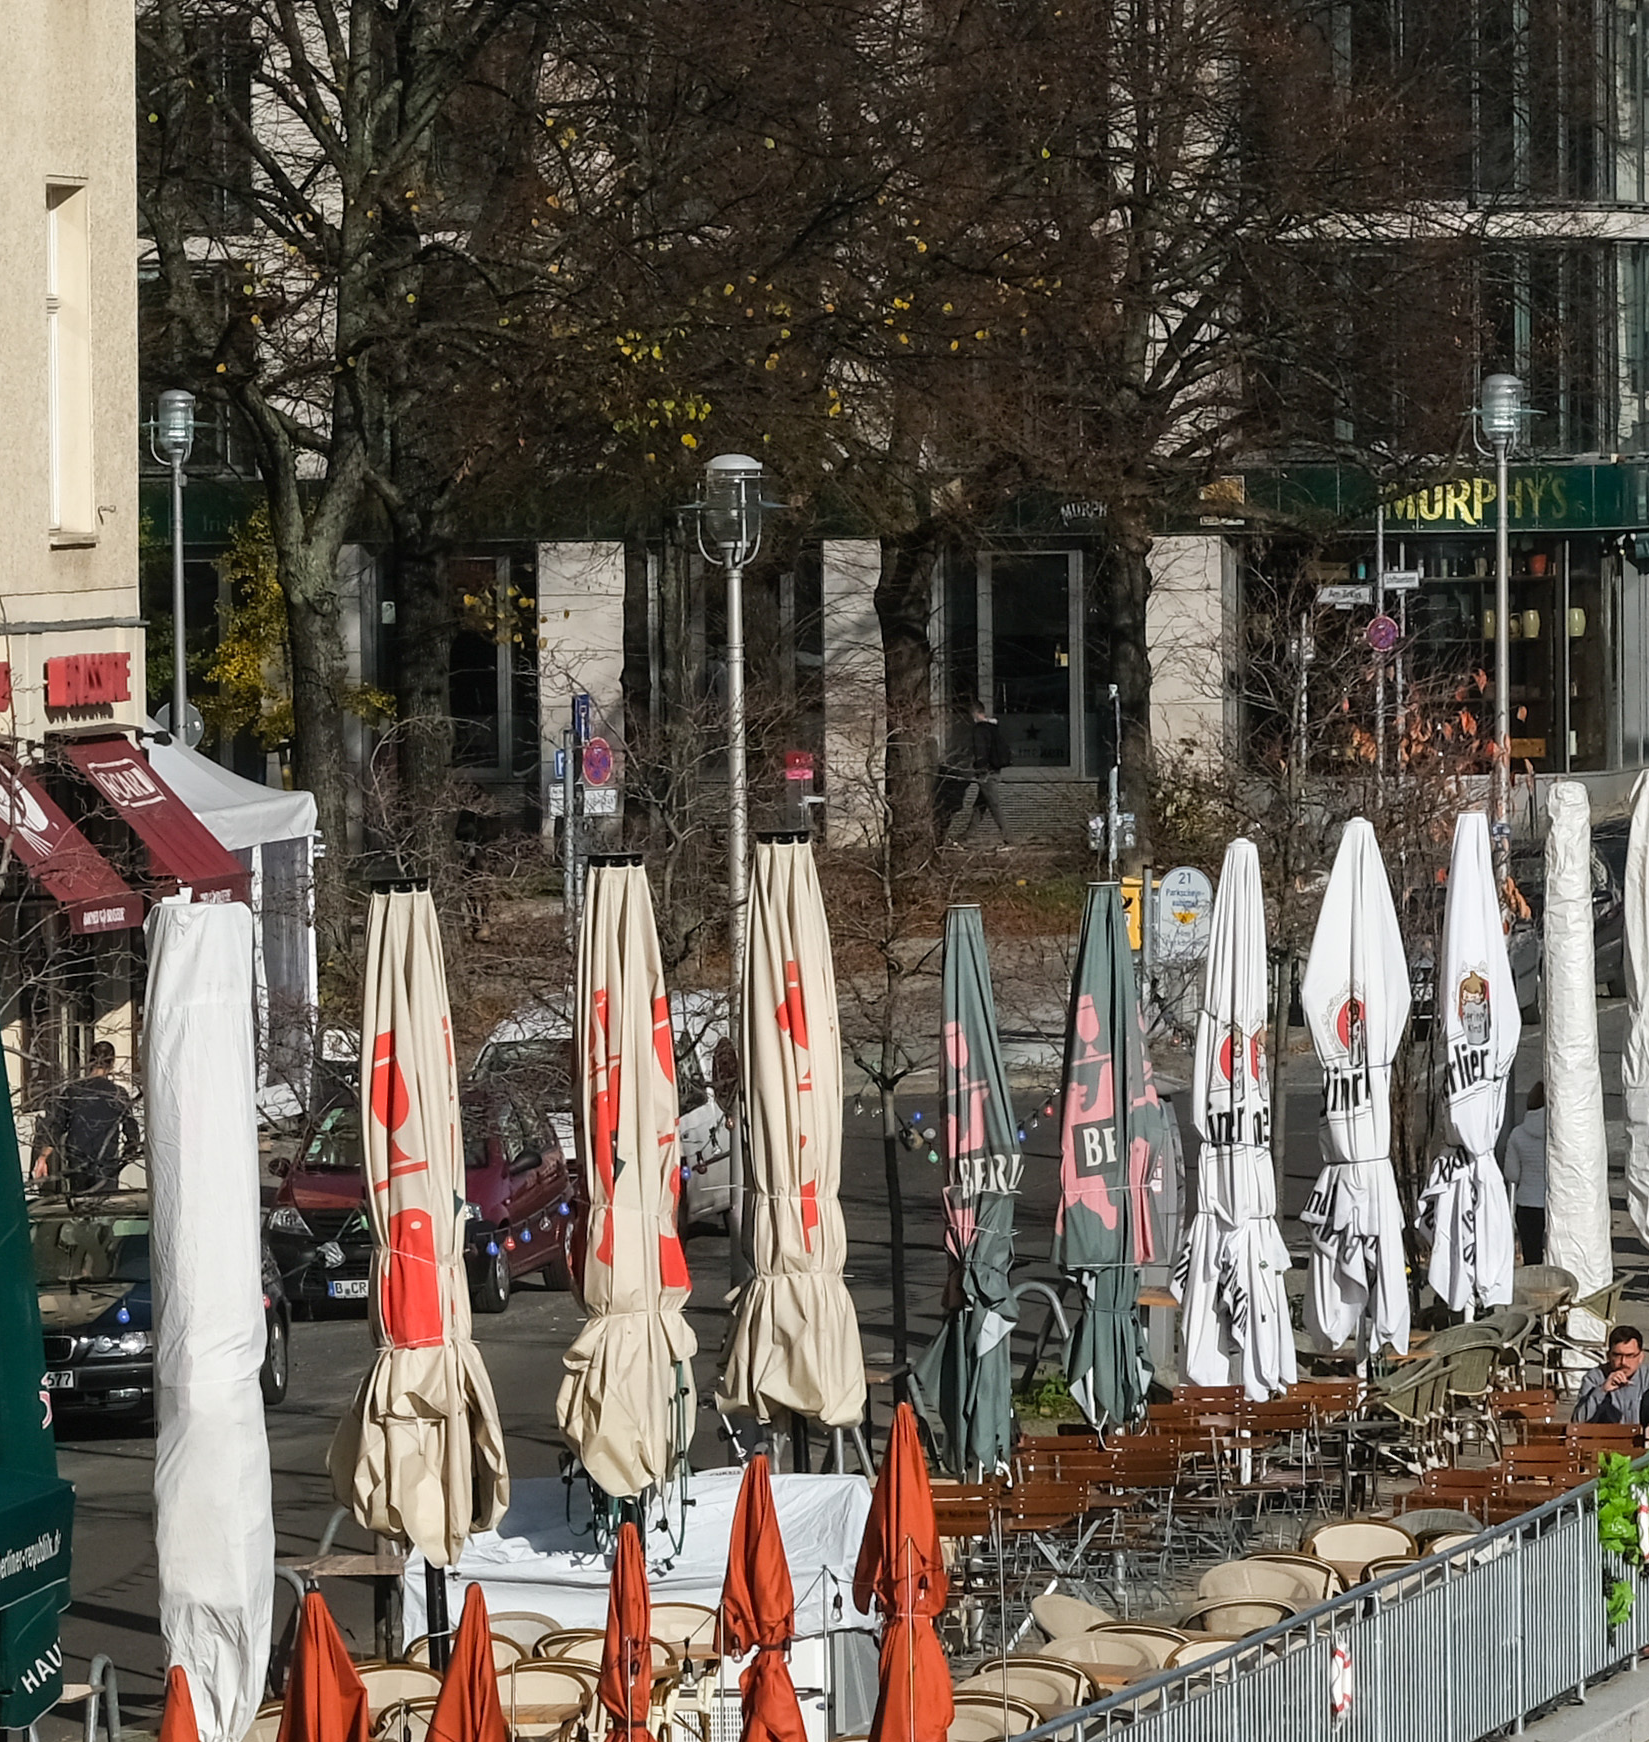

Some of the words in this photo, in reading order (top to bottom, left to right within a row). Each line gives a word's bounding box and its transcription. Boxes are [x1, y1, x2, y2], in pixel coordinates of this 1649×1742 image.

[1178, 872, 1192, 885] 21
[334, 1282, 344, 1295] B
[351, 1281, 368, 1295] CR
